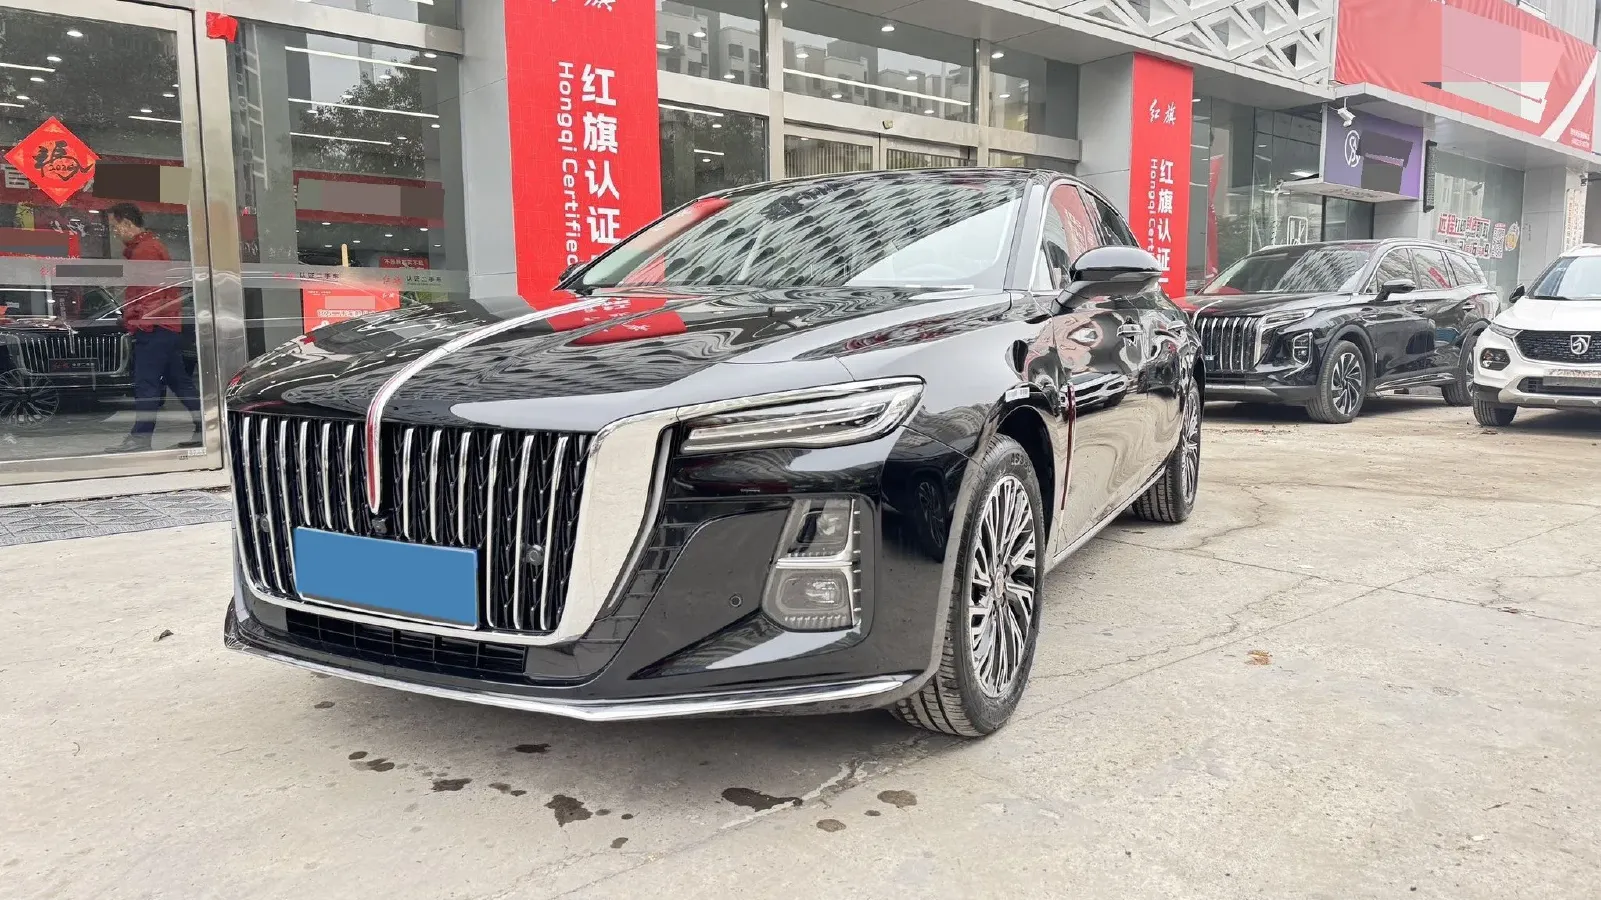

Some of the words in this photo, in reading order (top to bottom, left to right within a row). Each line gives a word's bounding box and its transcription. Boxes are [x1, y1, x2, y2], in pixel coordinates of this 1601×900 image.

[557, 61, 578, 153] Hongqi
[1149, 99, 1177, 125] 红旗
[580, 63, 622, 259] 红旗认证
[1147, 158, 1158, 214] Hongqi
